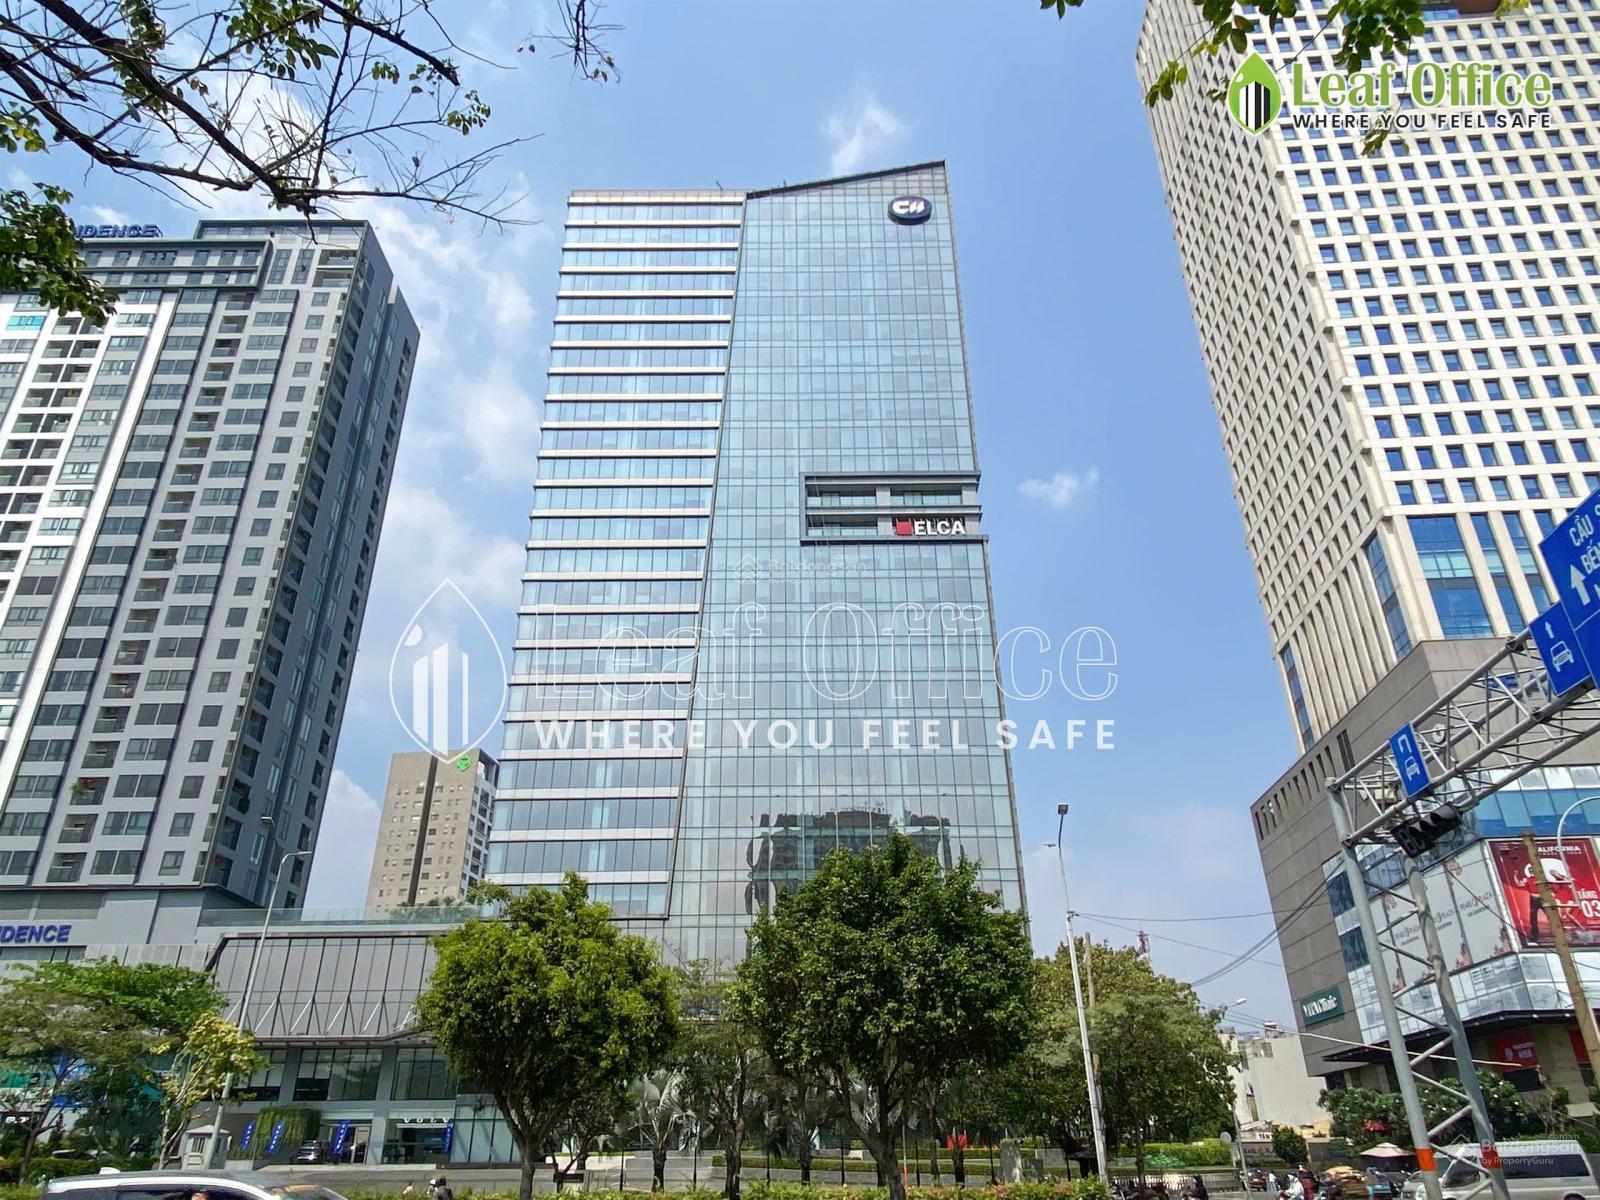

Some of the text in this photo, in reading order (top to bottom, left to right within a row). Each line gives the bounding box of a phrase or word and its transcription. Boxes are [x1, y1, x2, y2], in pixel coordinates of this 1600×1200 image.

[76, 224, 158, 238] IDENCE
[913, 520, 966, 536] ELCA
[1569, 514, 1594, 547] CẦU
[0, 925, 72, 943] DENCE
